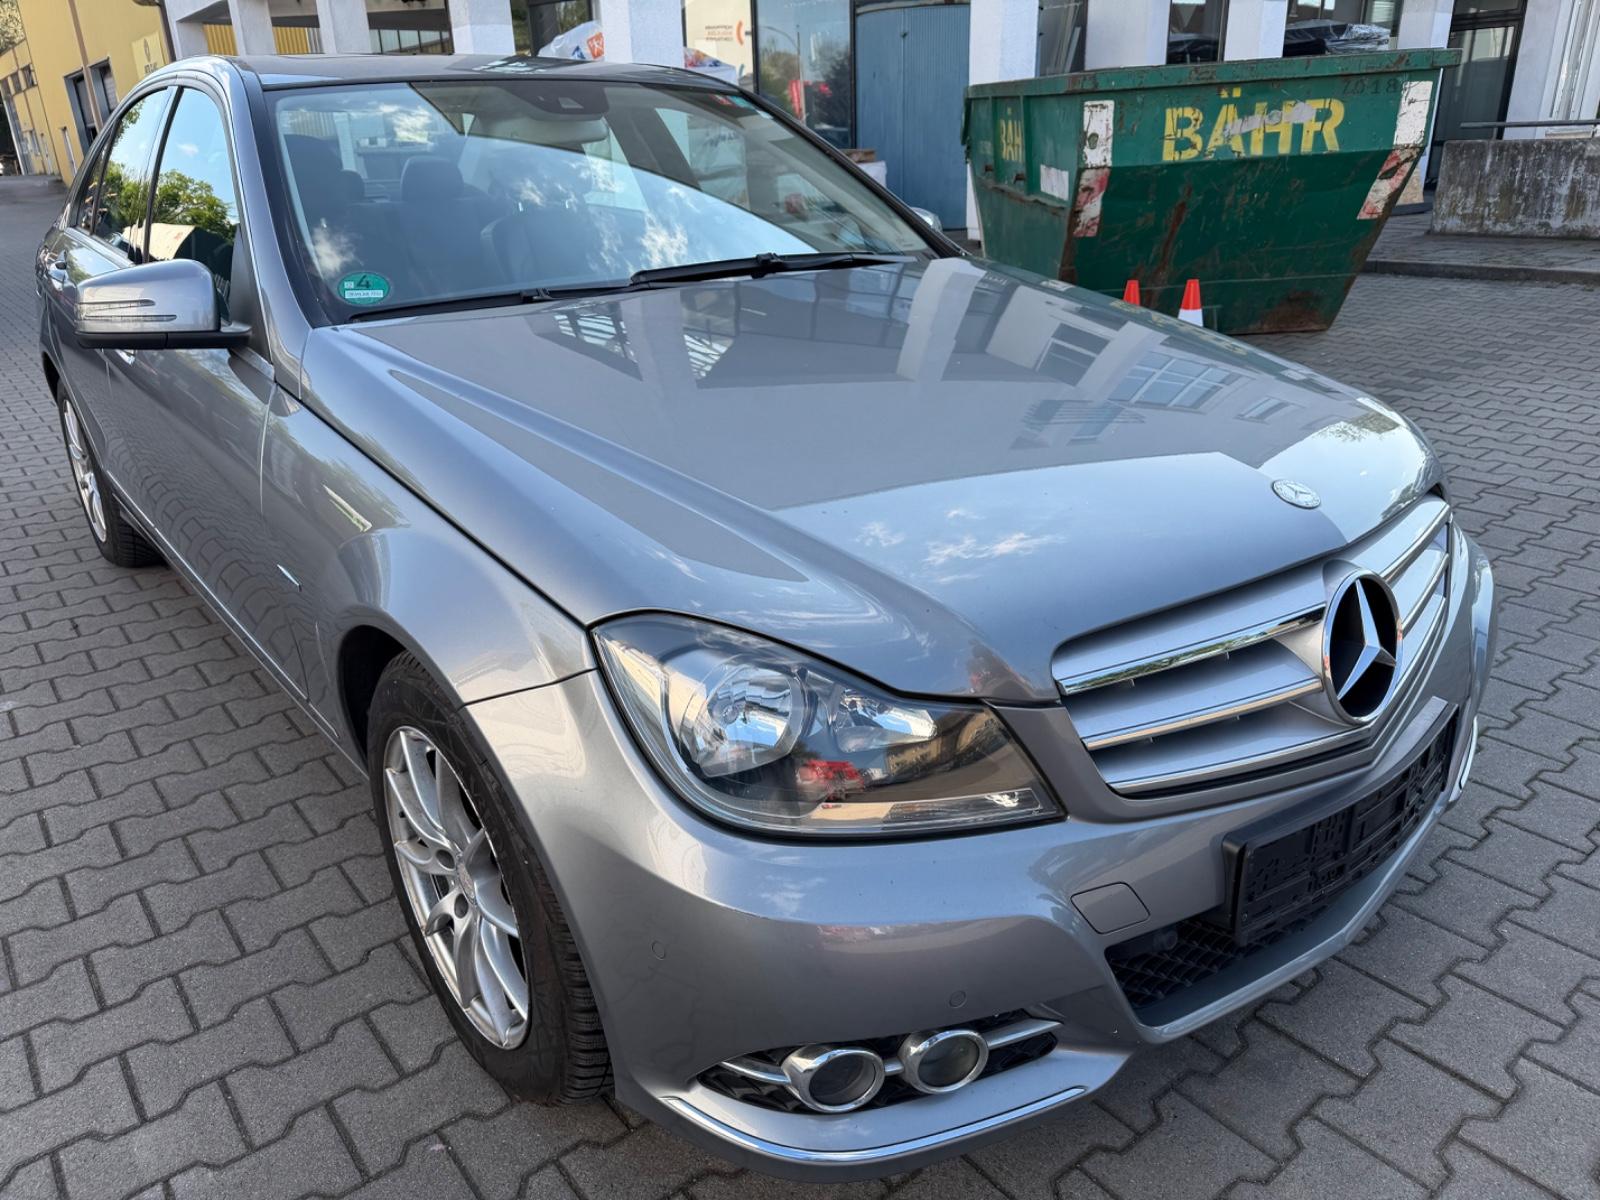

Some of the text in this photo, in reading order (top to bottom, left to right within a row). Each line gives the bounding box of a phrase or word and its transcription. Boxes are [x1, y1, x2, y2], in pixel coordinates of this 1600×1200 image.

[999, 107, 1023, 163] BÄH
[1161, 87, 1346, 162] BÄHR
[356, 274, 372, 289] 4
